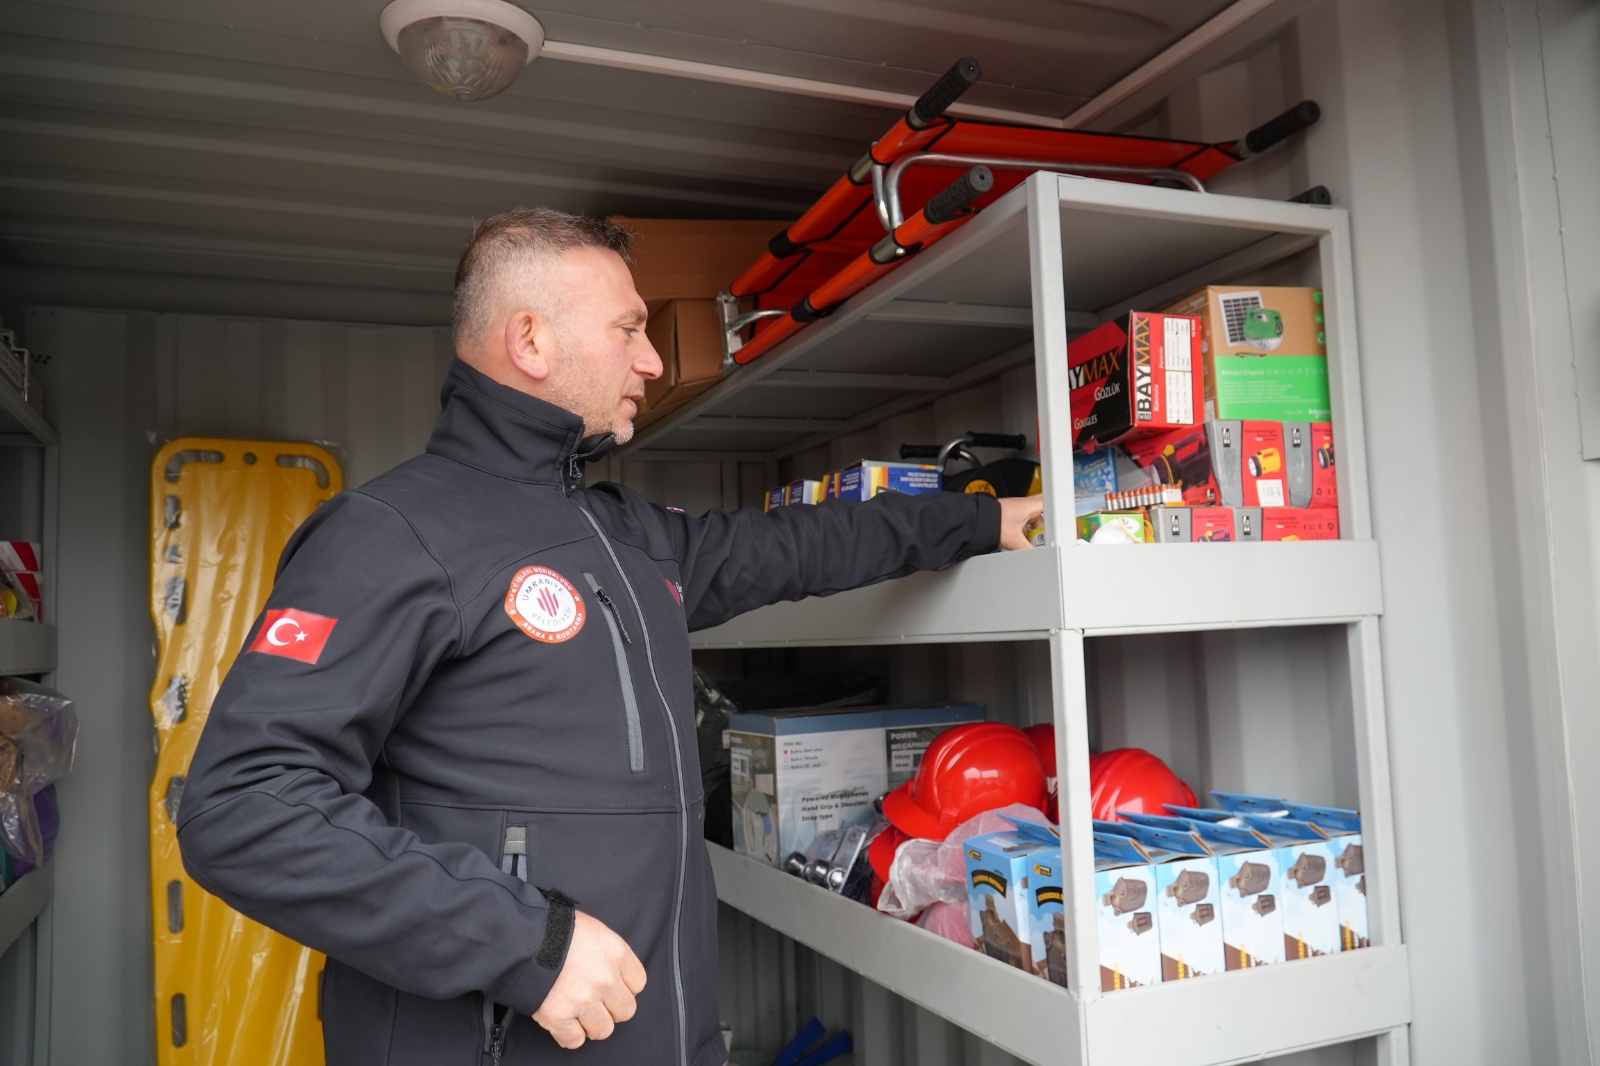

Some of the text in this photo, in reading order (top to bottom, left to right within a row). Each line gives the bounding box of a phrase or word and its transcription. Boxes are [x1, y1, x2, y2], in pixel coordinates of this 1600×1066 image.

[1068, 346, 1120, 391] YMAX
[1136, 317, 1152, 412] BAYMAX
[1094, 382, 1121, 401] GÖZLÜK
[1074, 414, 1098, 430] GOGGLES
[522, 622, 546, 639] ARAMA
[556, 612, 582, 640] KURTARMA
[891, 732, 917, 740] POWER
[891, 741, 930, 750] MEGAPHON
[830, 791, 869, 800] Megaphones
